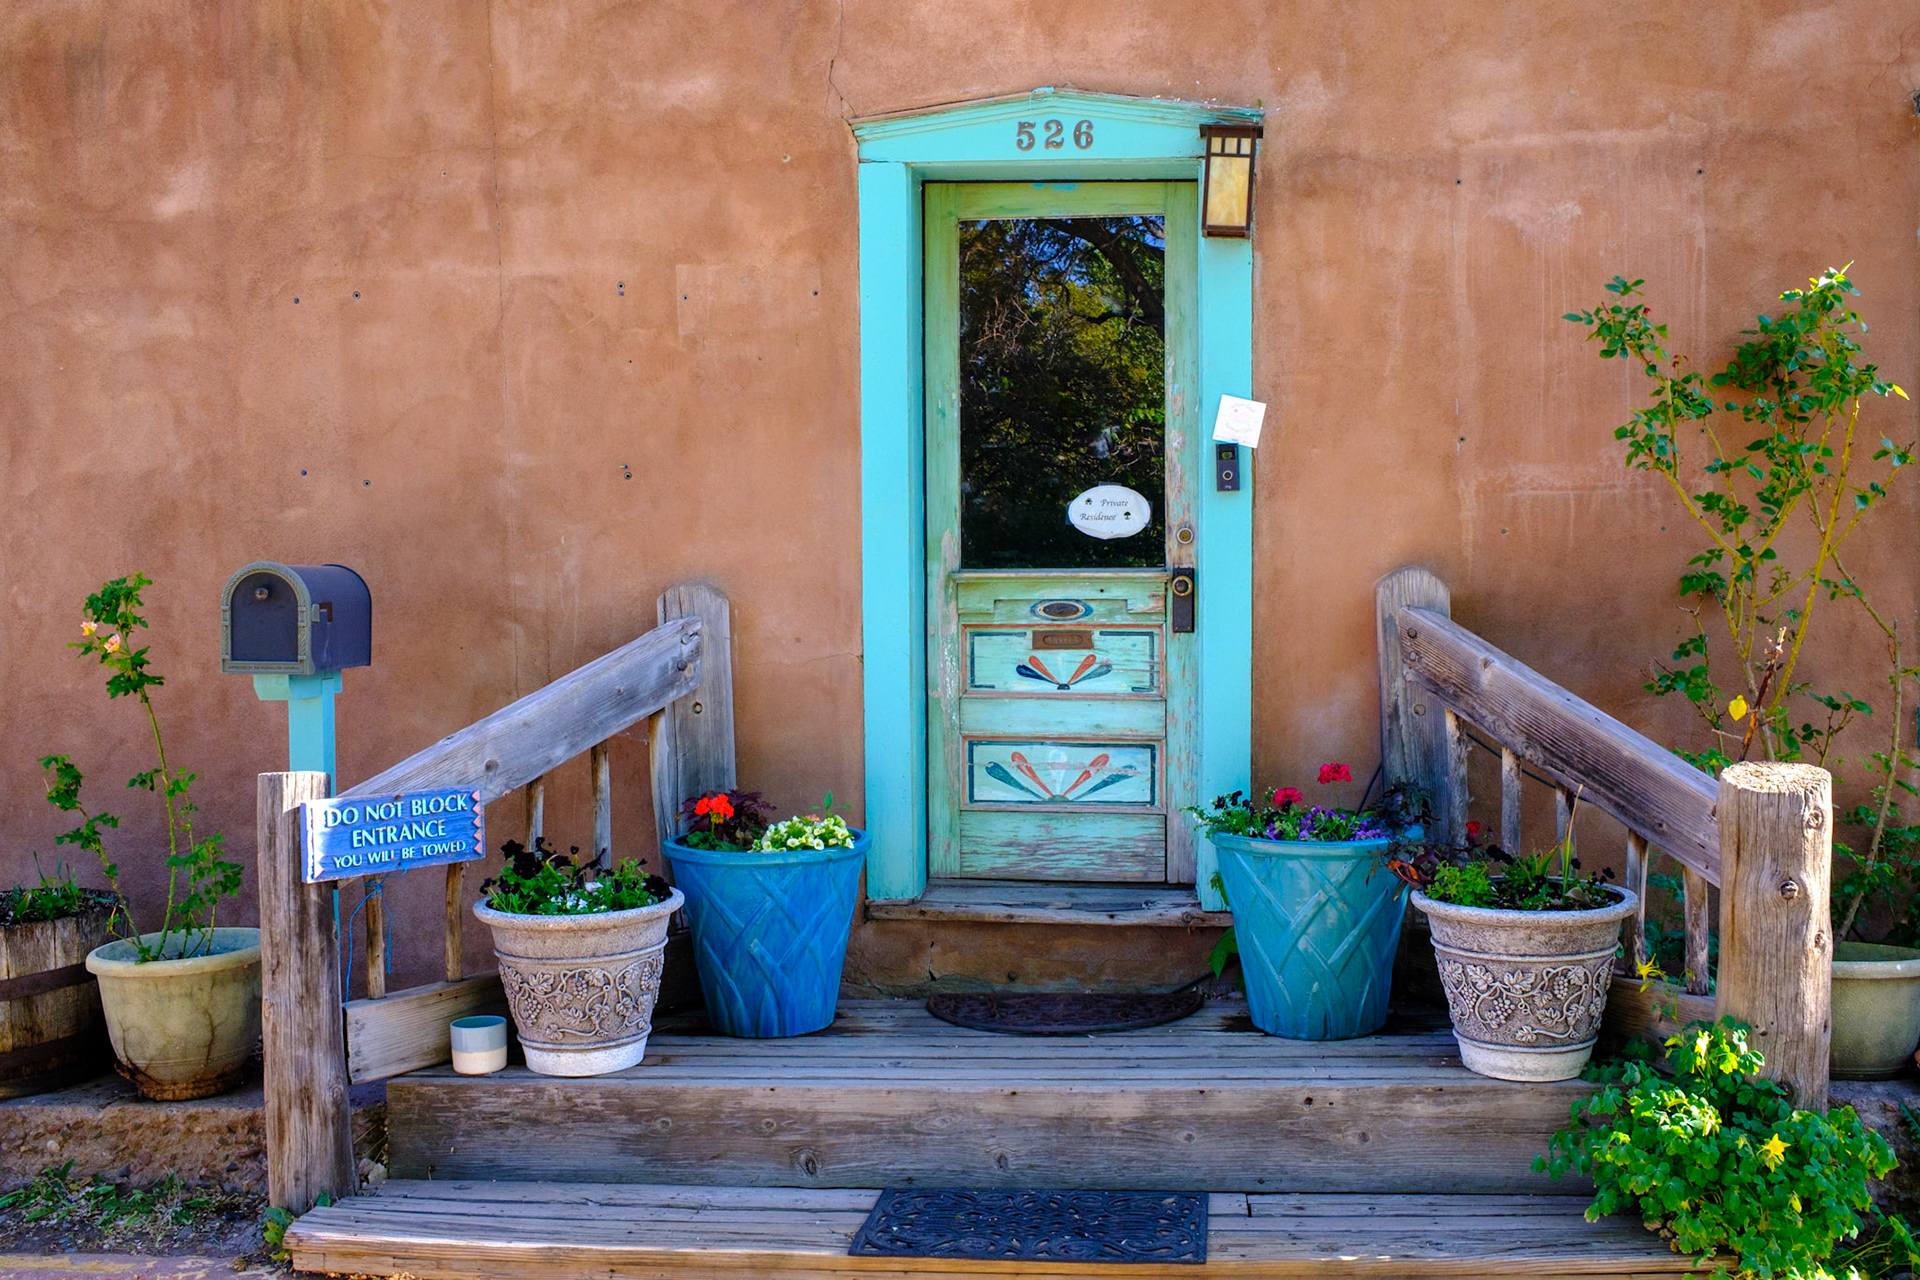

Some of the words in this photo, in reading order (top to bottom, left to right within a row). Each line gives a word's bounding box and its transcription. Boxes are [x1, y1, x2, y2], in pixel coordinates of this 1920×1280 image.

[1016, 119, 1094, 152] 526
[1080, 511, 1116, 521] Residence
[1100, 499, 1129, 507] Private
[326, 807, 359, 827] DO
[365, 801, 404, 822] NOT
[411, 794, 468, 816] BLOCK
[353, 819, 446, 847] ENTRANCE
[333, 855, 362, 868] YOU
[367, 851, 394, 863] WILL
[401, 848, 415, 860] BE
[422, 841, 465, 856] TOWED
